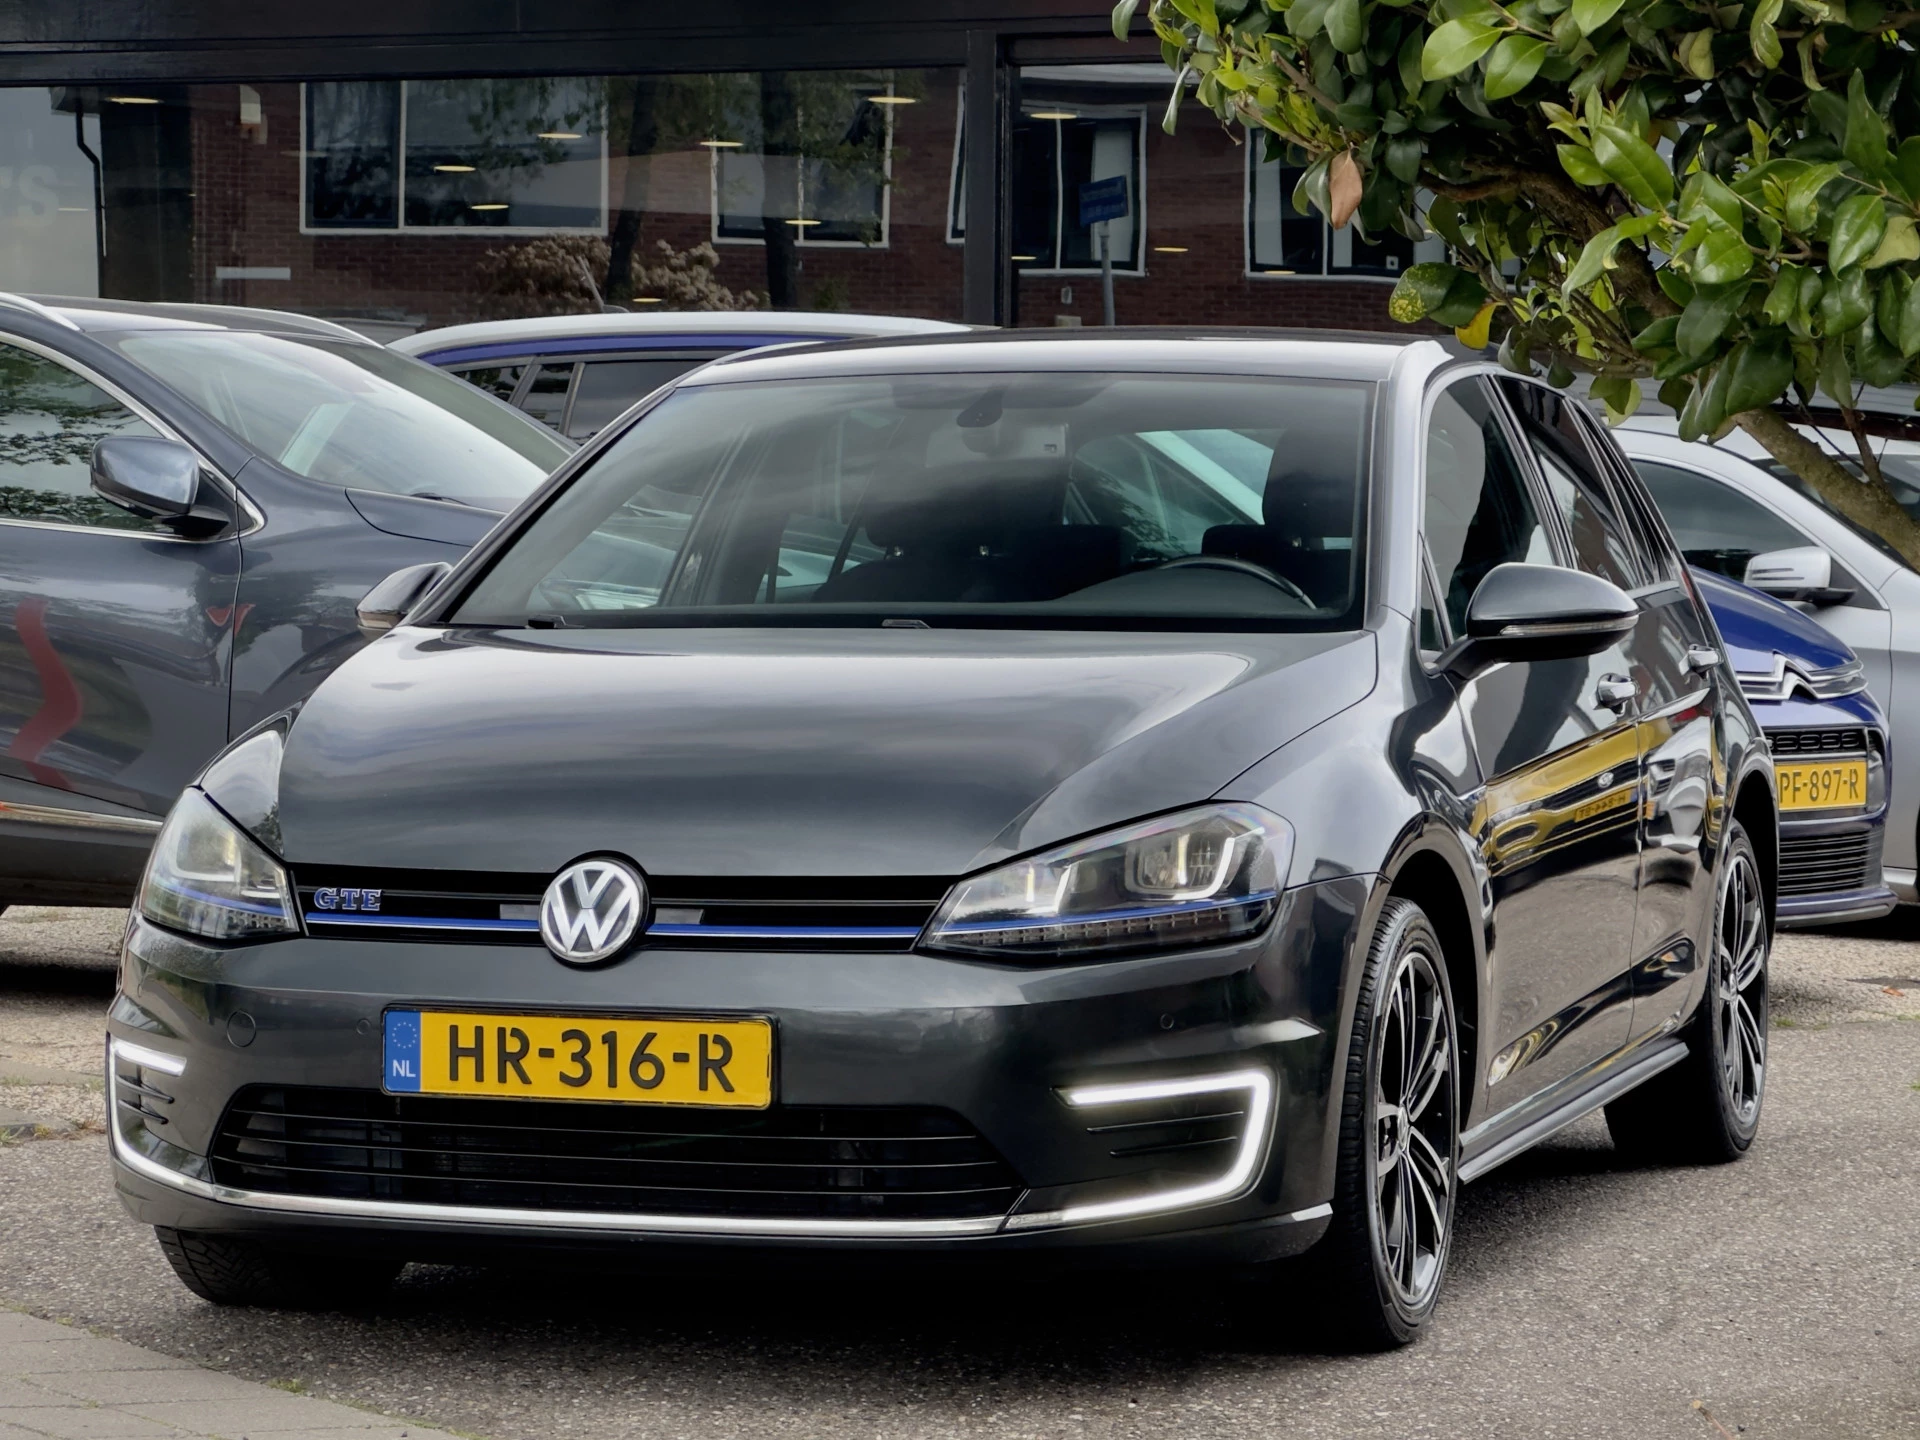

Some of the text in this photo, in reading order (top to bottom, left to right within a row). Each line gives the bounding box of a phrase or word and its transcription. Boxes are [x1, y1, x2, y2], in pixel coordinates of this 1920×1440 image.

[1779, 768, 1859, 804] PF-897-R
[314, 888, 381, 911] GTE
[392, 1060, 417, 1078] NL
[449, 1024, 736, 1093] HR-316-R
